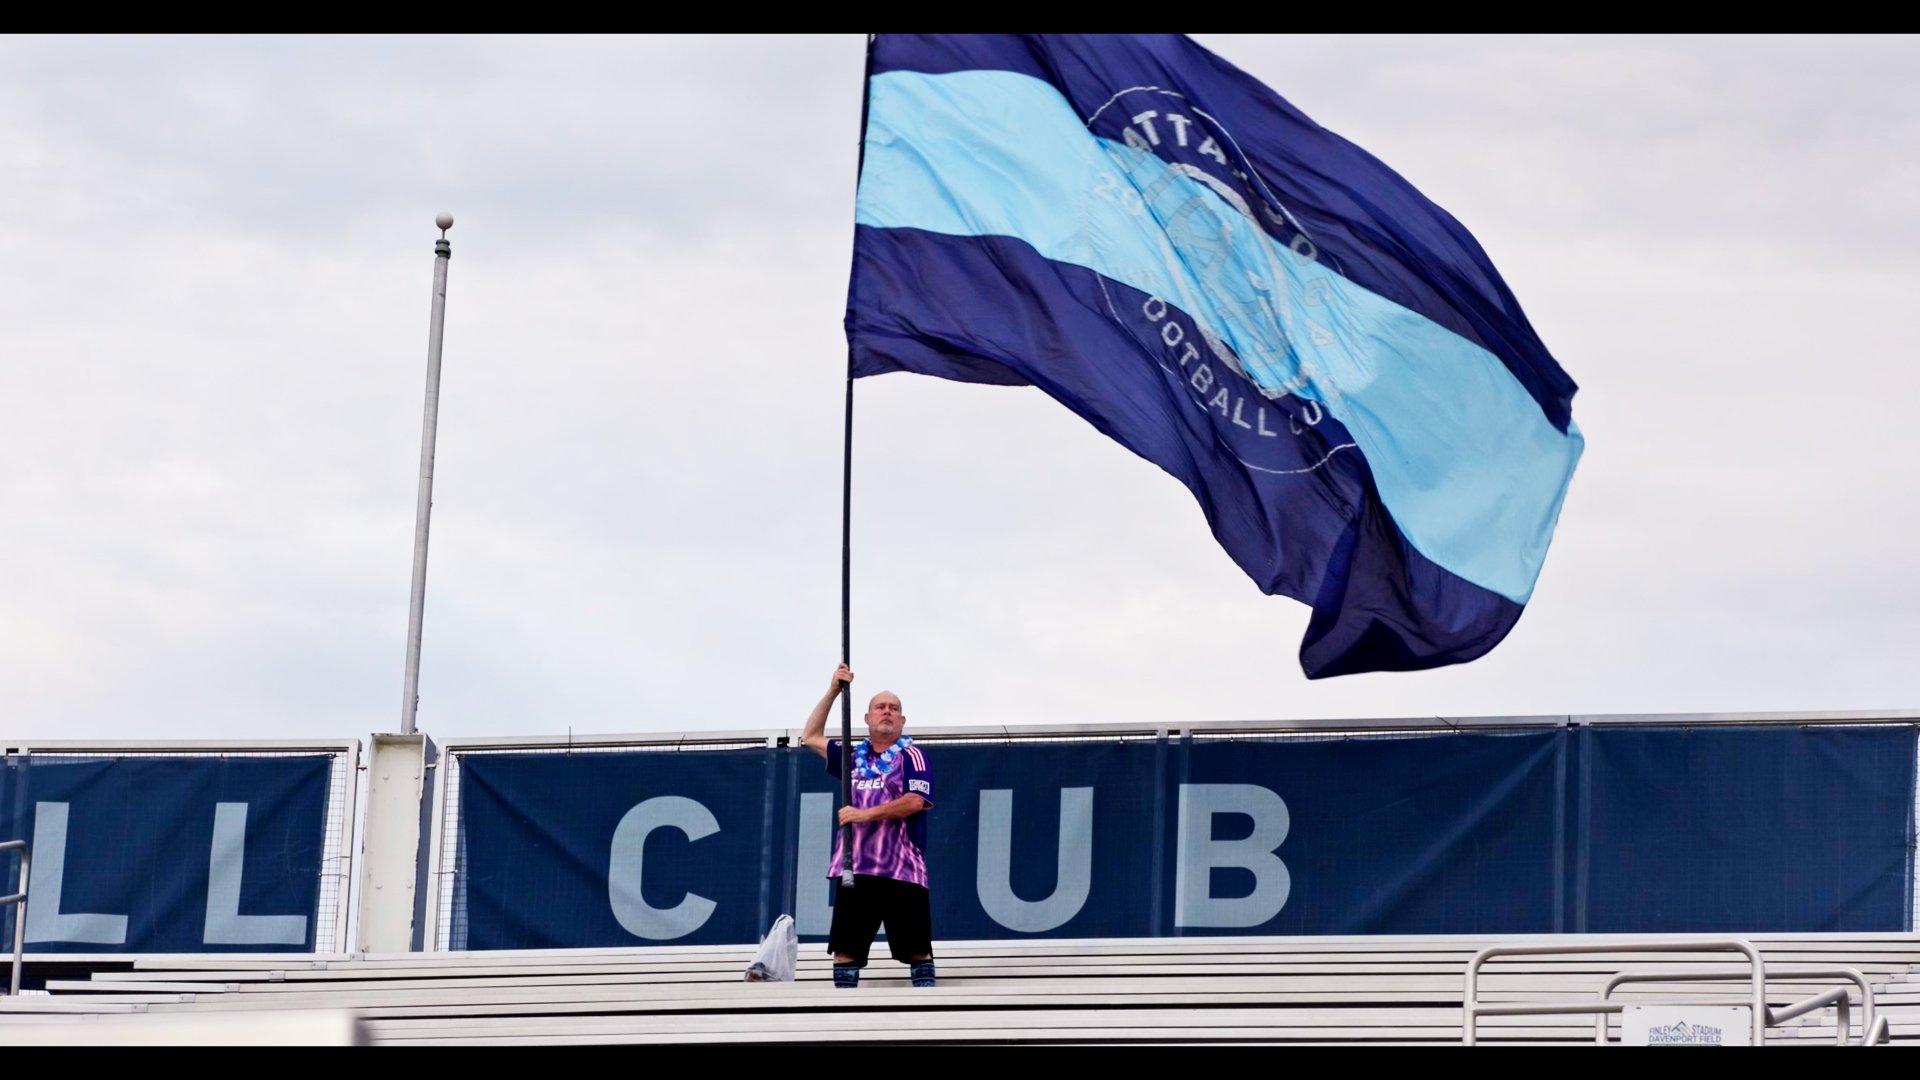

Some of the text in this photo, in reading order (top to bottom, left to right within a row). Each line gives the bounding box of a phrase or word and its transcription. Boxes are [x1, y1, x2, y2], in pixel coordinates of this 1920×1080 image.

[1138, 294, 1278, 438] OOTBALL
[1649, 1025, 1722, 1035] FINLEY STADIUM
[1648, 1035, 1722, 1043] DAVENPORT FIELD
